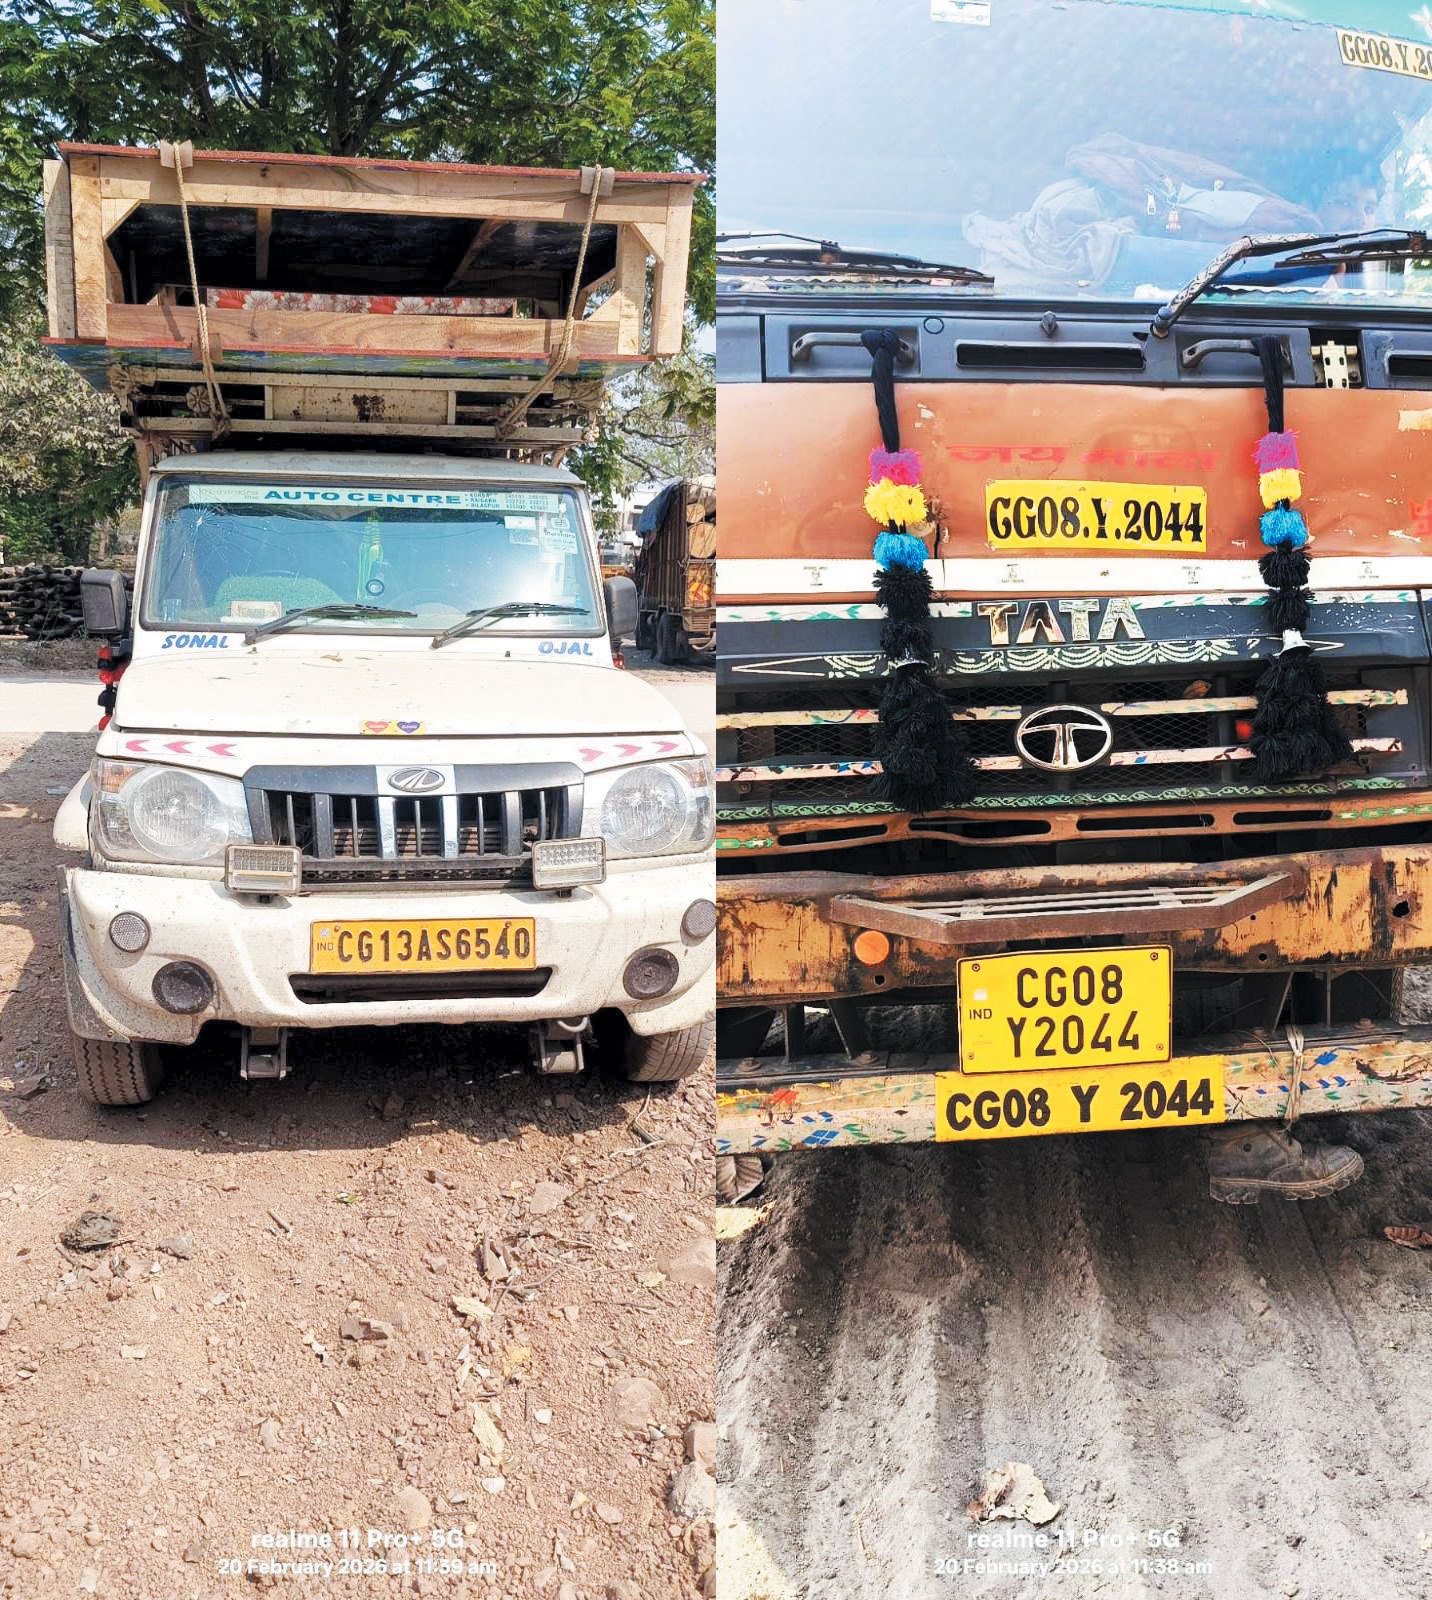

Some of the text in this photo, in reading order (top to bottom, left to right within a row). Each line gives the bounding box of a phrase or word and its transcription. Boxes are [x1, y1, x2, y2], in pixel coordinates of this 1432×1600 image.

[264, 490, 340, 501] AUTO
[348, 492, 461, 504] CENTRE
[989, 496, 1203, 542] CG08.Y.2044
[977, 599, 1146, 645] TATA
[161, 634, 229, 649] SONAL
[538, 640, 593, 656] OJAL
[316, 942, 334, 952] IND
[338, 927, 530, 963] CG13AS6540
[1016, 964, 1123, 1009] CG08
[969, 1008, 993, 1021] IND
[1007, 1010, 1140, 1058] Y2044
[946, 1078, 1215, 1132] CG08 Y 2044
